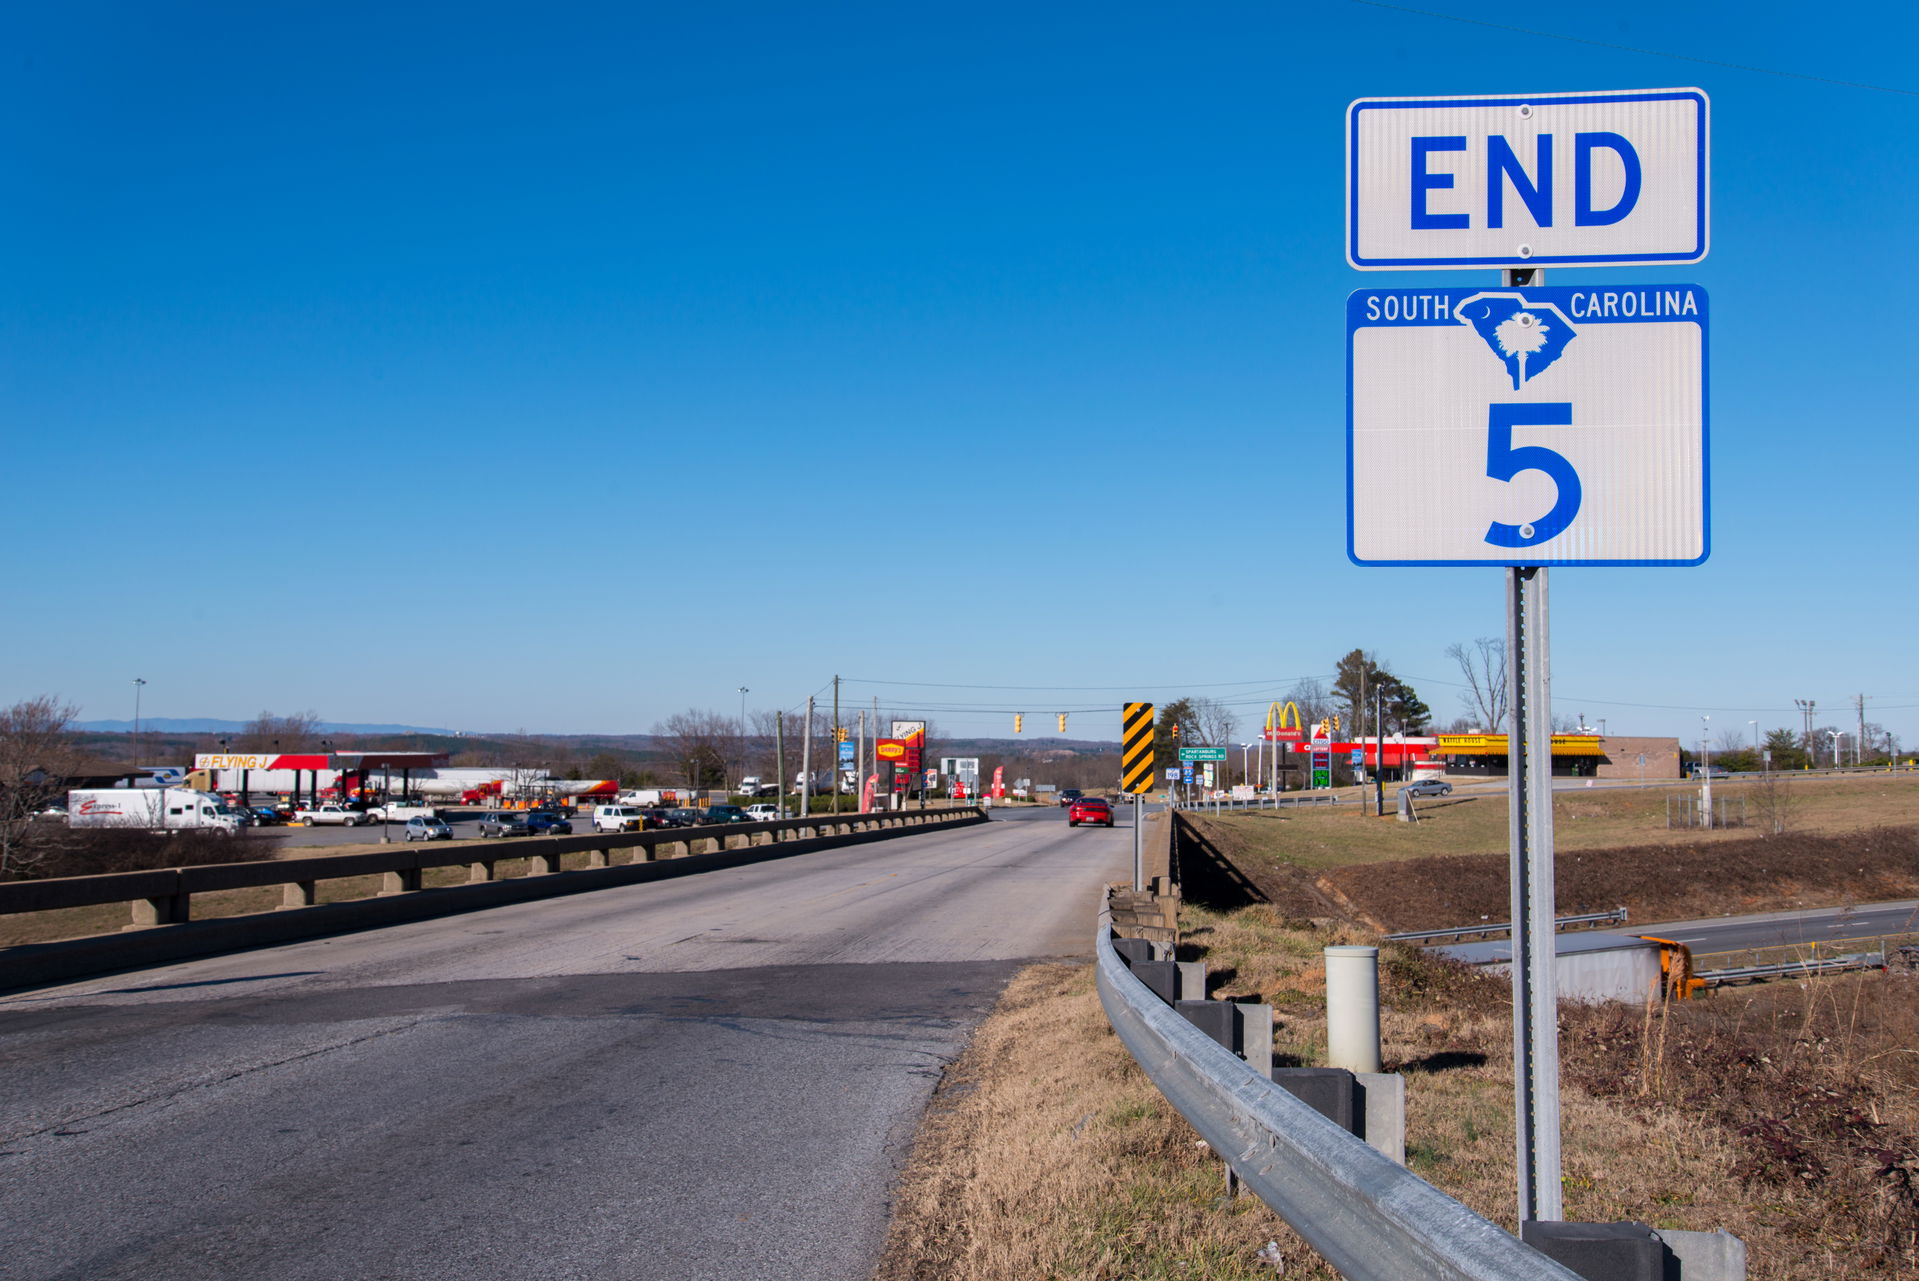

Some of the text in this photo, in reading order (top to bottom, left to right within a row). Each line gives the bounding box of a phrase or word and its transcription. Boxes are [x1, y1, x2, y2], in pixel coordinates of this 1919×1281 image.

[1410, 131, 1642, 230] END
[1366, 289, 1698, 322] SOUTH CAROLINA
[1483, 402, 1582, 548] 5
[211, 755, 267, 768] FLYING J
